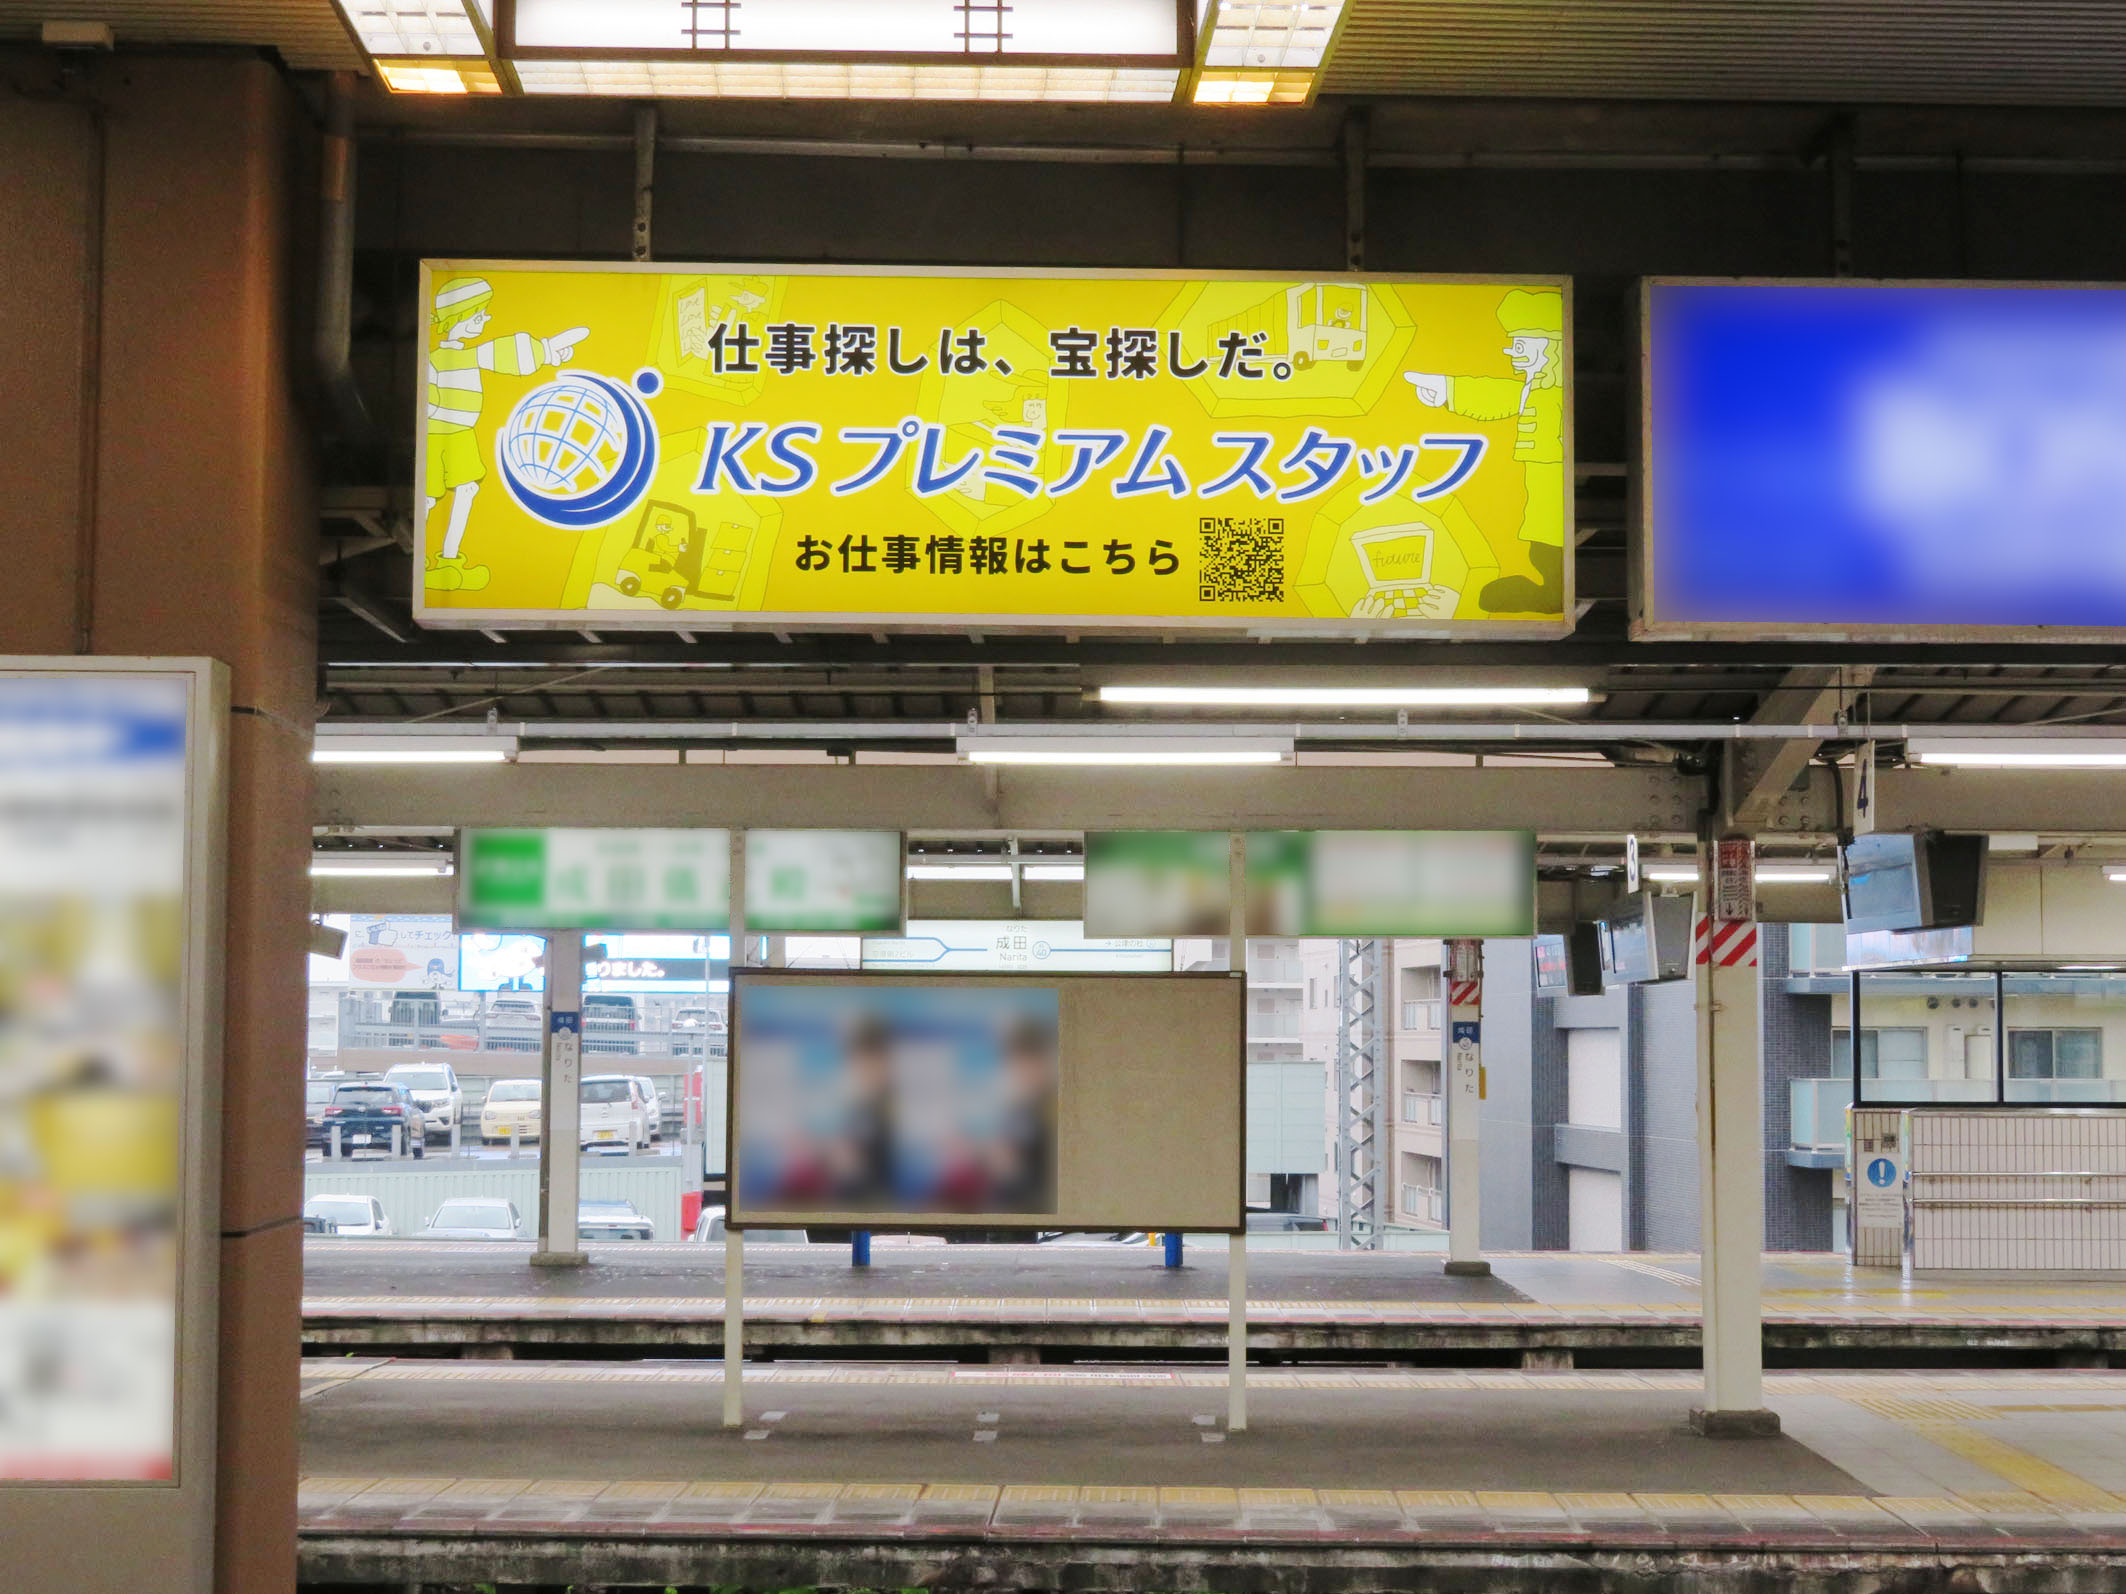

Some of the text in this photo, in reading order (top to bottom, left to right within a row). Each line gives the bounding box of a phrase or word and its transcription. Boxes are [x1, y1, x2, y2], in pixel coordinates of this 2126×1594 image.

[708, 323, 1291, 380] 仕事探しは、宝探しだ。
[795, 534, 1179, 576] お仕事情報はこちら
[1629, 838, 1637, 882] 3
[996, 935, 1027, 950] 成田
[1000, 952, 1027, 962] Narita
[1465, 1053, 1474, 1094] なりた
